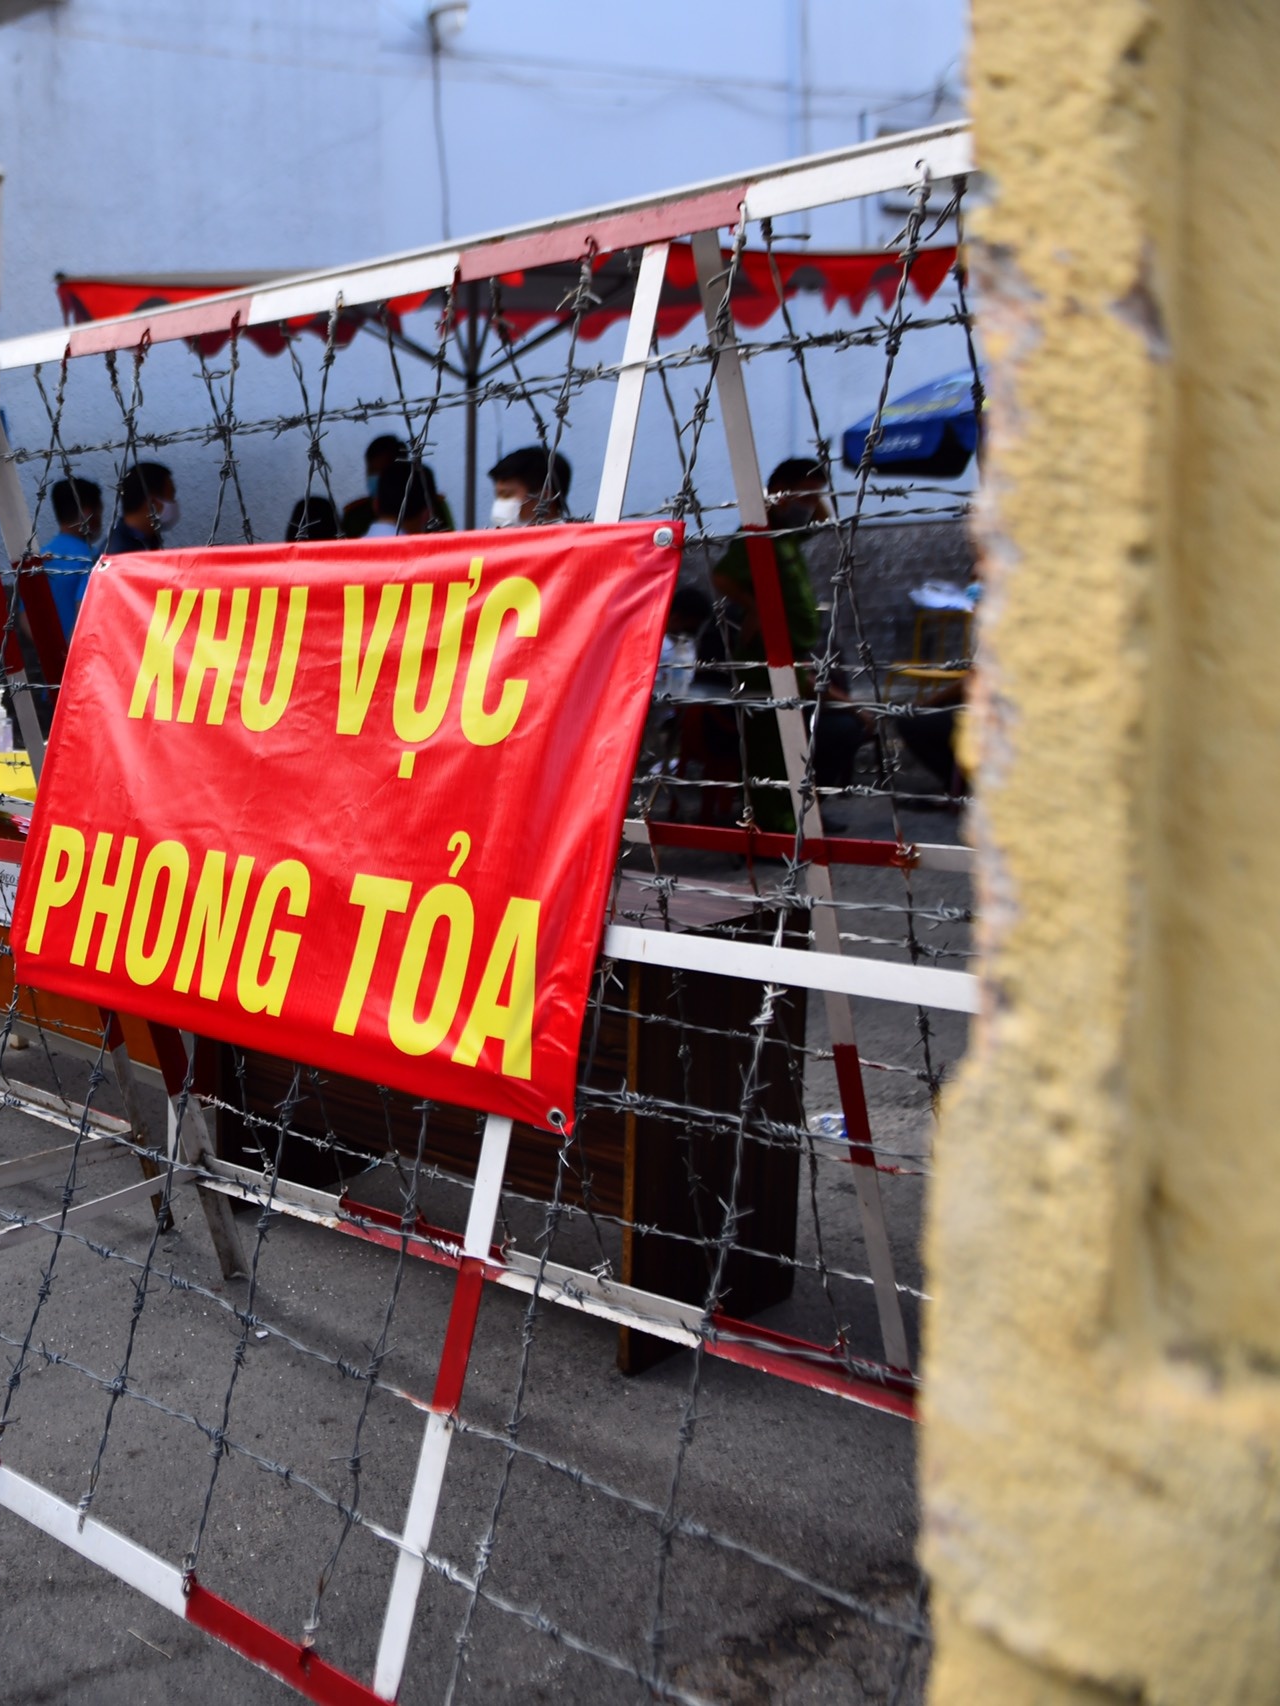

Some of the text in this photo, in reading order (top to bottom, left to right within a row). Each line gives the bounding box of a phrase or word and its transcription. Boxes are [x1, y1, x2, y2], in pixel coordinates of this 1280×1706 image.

[127, 557, 541, 779] KHU VỰC
[26, 824, 541, 1080] PHONG TỎA
